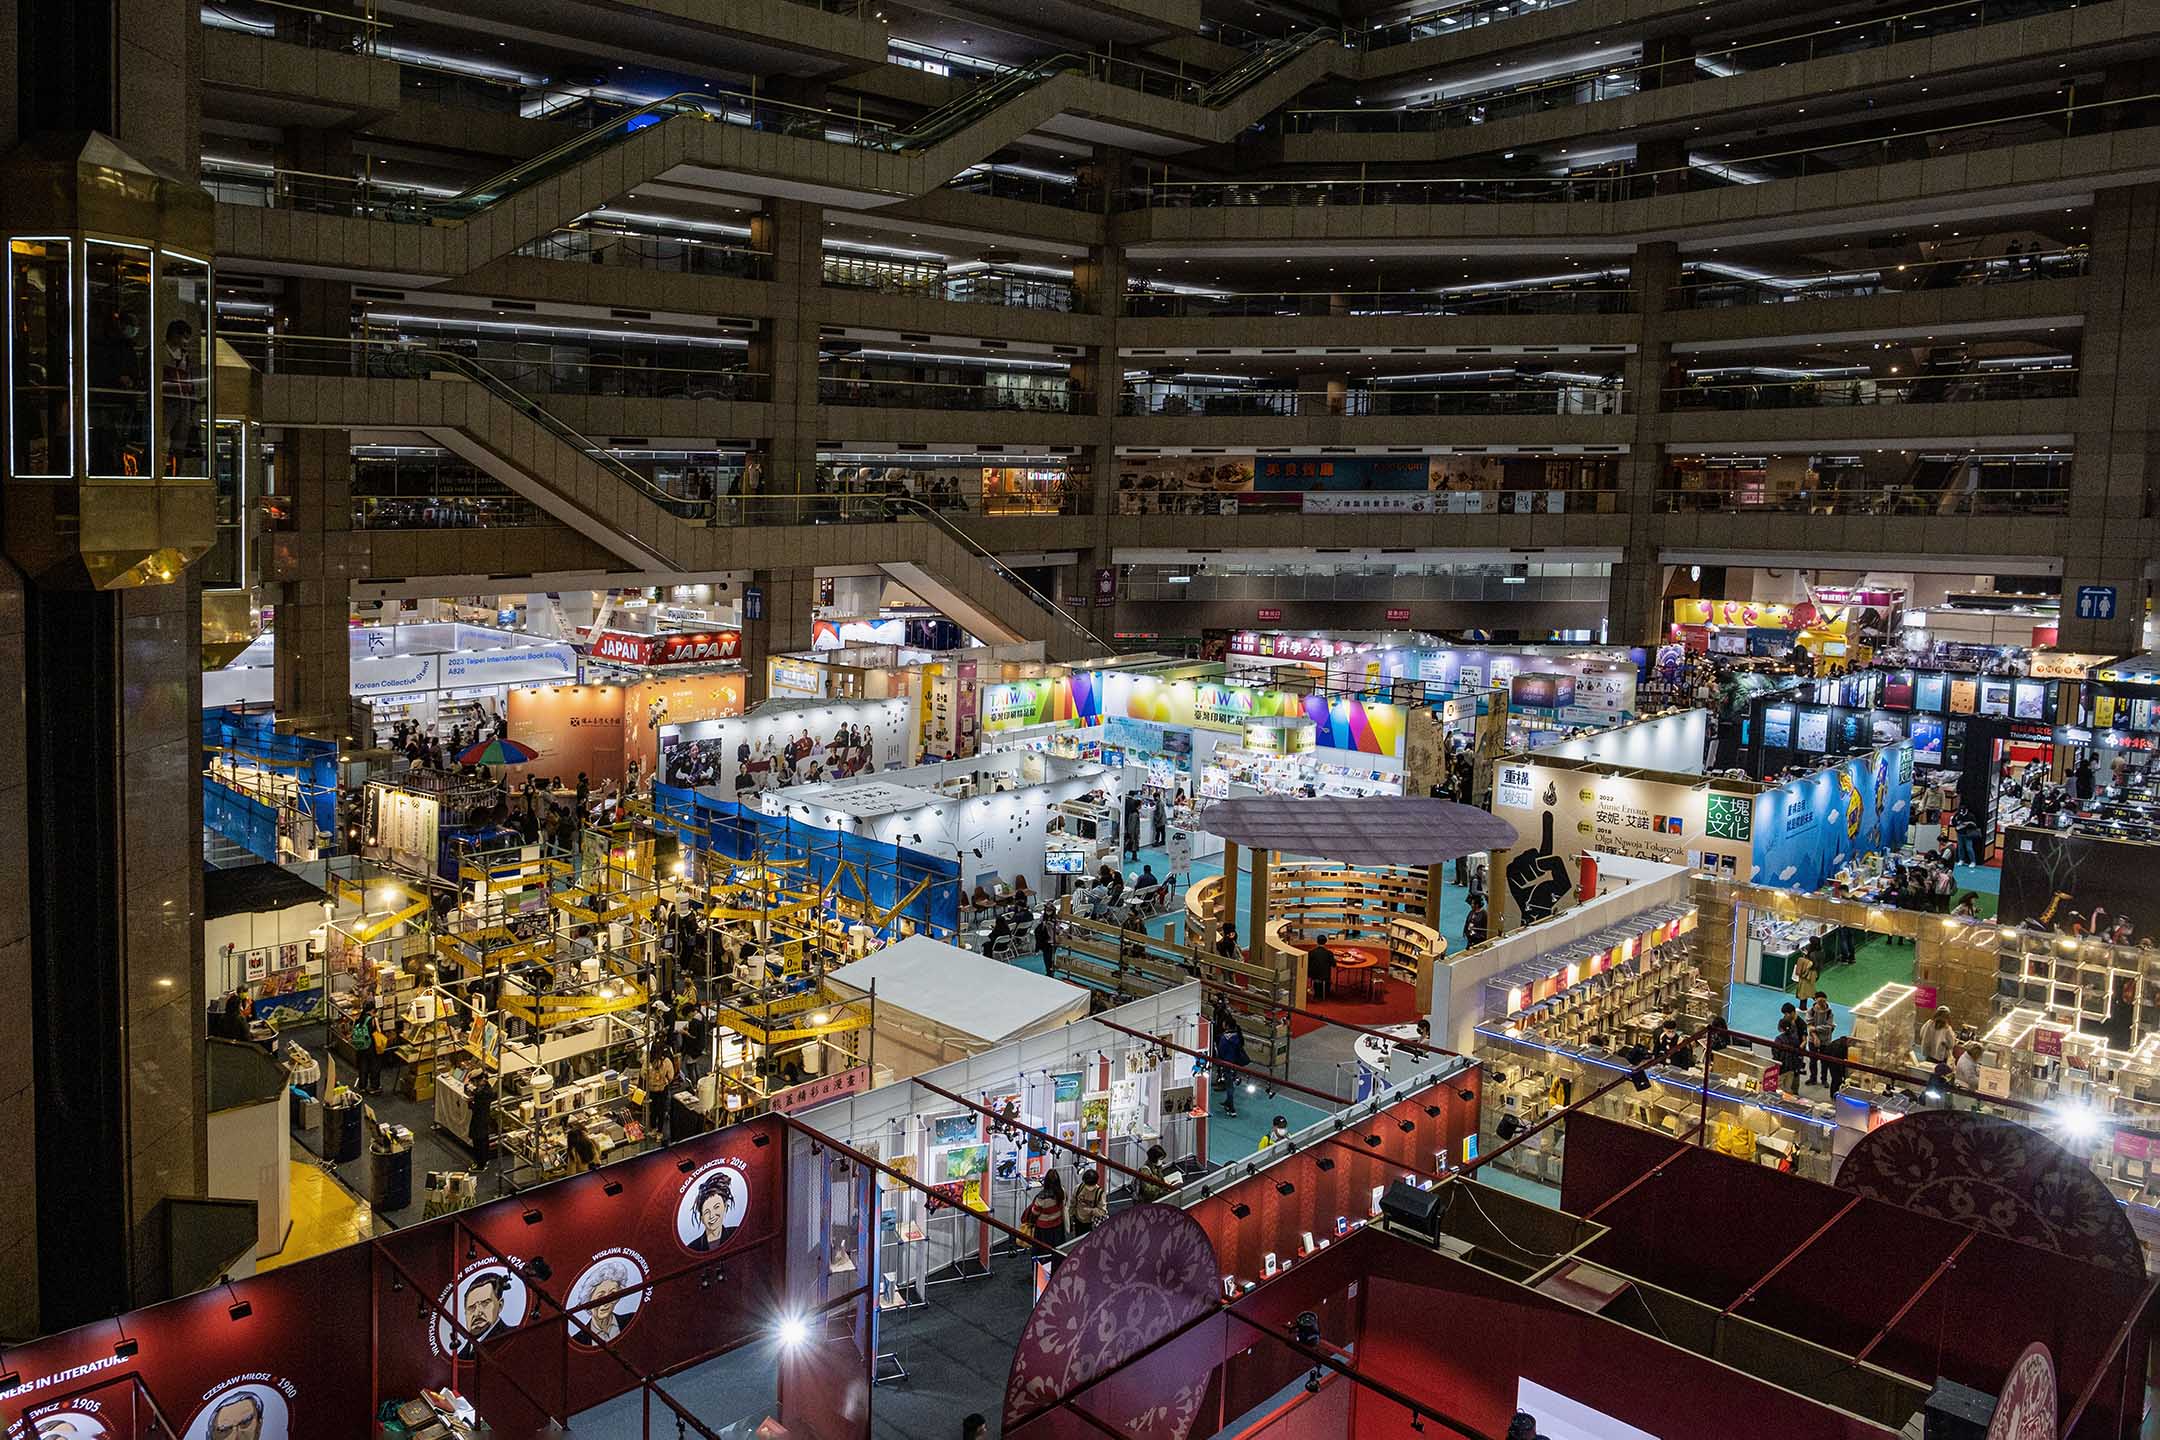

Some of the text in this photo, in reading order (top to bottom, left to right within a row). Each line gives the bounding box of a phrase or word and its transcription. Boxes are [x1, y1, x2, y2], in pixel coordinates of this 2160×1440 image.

[601, 639, 639, 660] JAPAN
[668, 640, 737, 661] JAPAN
[448, 657, 464, 666] 2023
[466, 656, 485, 666] Taipei
[486, 654, 526, 664] International
[527, 652, 544, 661] Book
[354, 660, 430, 690] Korean Collective Stand
[990, 688, 1037, 707] TAIWAN
[1195, 686, 1253, 710] TAIWAN
[1194, 709, 1244, 726] 臺灣印刷精品
[2010, 732, 2052, 741] ThinKingDom
[1504, 769, 1530, 787] 重構
[1599, 794, 1615, 802] 2022
[1708, 796, 1750, 816] 大塊
[1598, 801, 1649, 816] Annie Ernaux
[1596, 810, 1650, 830] 安妮·艾諾
[1708, 812, 1750, 824] LOCUS
[1707, 819, 1749, 840] 文化
[1595, 833, 1613, 847] Olga
[1645, 840, 1684, 856] Tokarczuk
[730, 1157, 748, 1171] 2018
[35, 1375, 52, 1389] IN
[202, 1372, 297, 1401] CZESŁAW MIŁOSZ 1980
[71, 1398, 101, 1413] 1905
